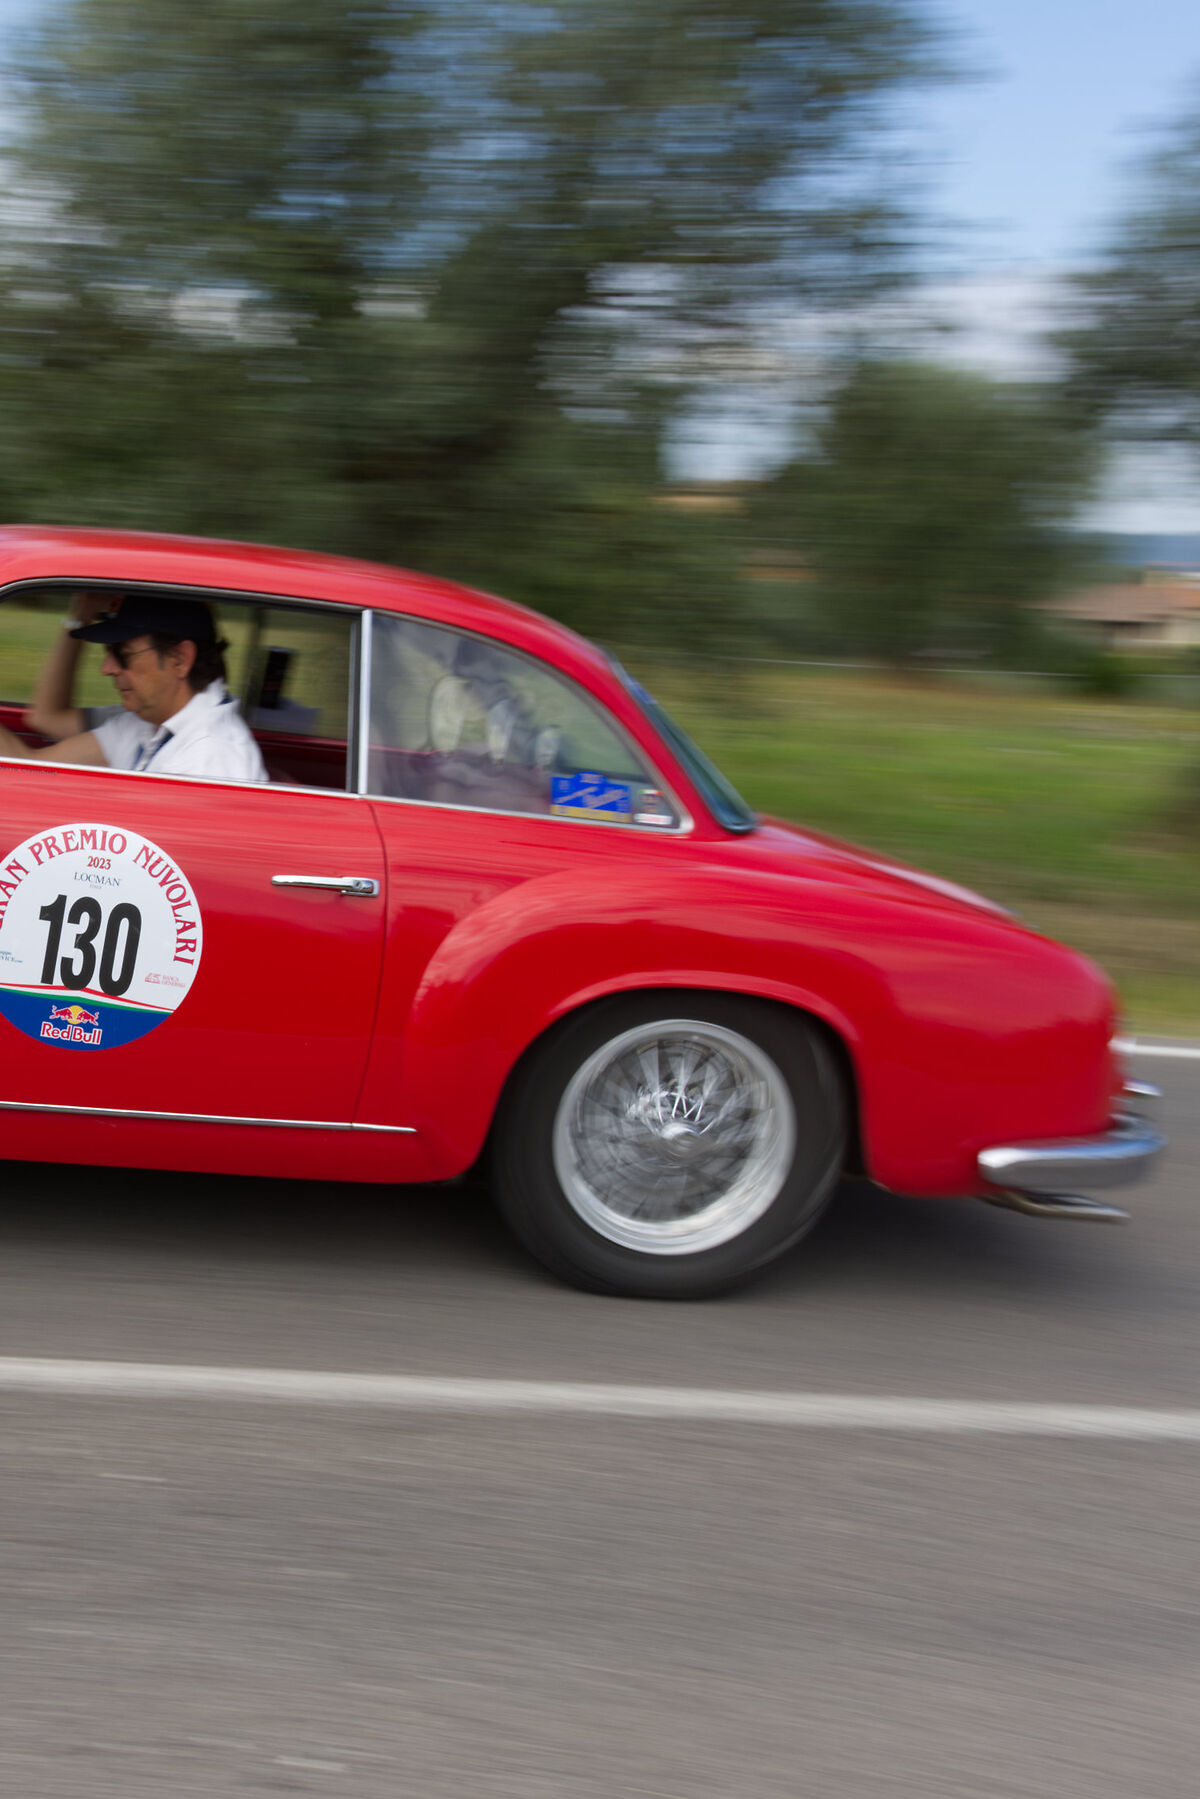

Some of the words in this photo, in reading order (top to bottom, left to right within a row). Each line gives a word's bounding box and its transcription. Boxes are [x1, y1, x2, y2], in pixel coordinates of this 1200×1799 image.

[87, 855, 112, 870] 2023
[74, 871, 121, 887] LOCMAN
[28, 829, 127, 866] PREMIO
[132, 844, 197, 966] NUVOLARI
[38, 894, 142, 997] 130
[41, 1021, 72, 1040] Red
[71, 1026, 102, 1045] Bull
